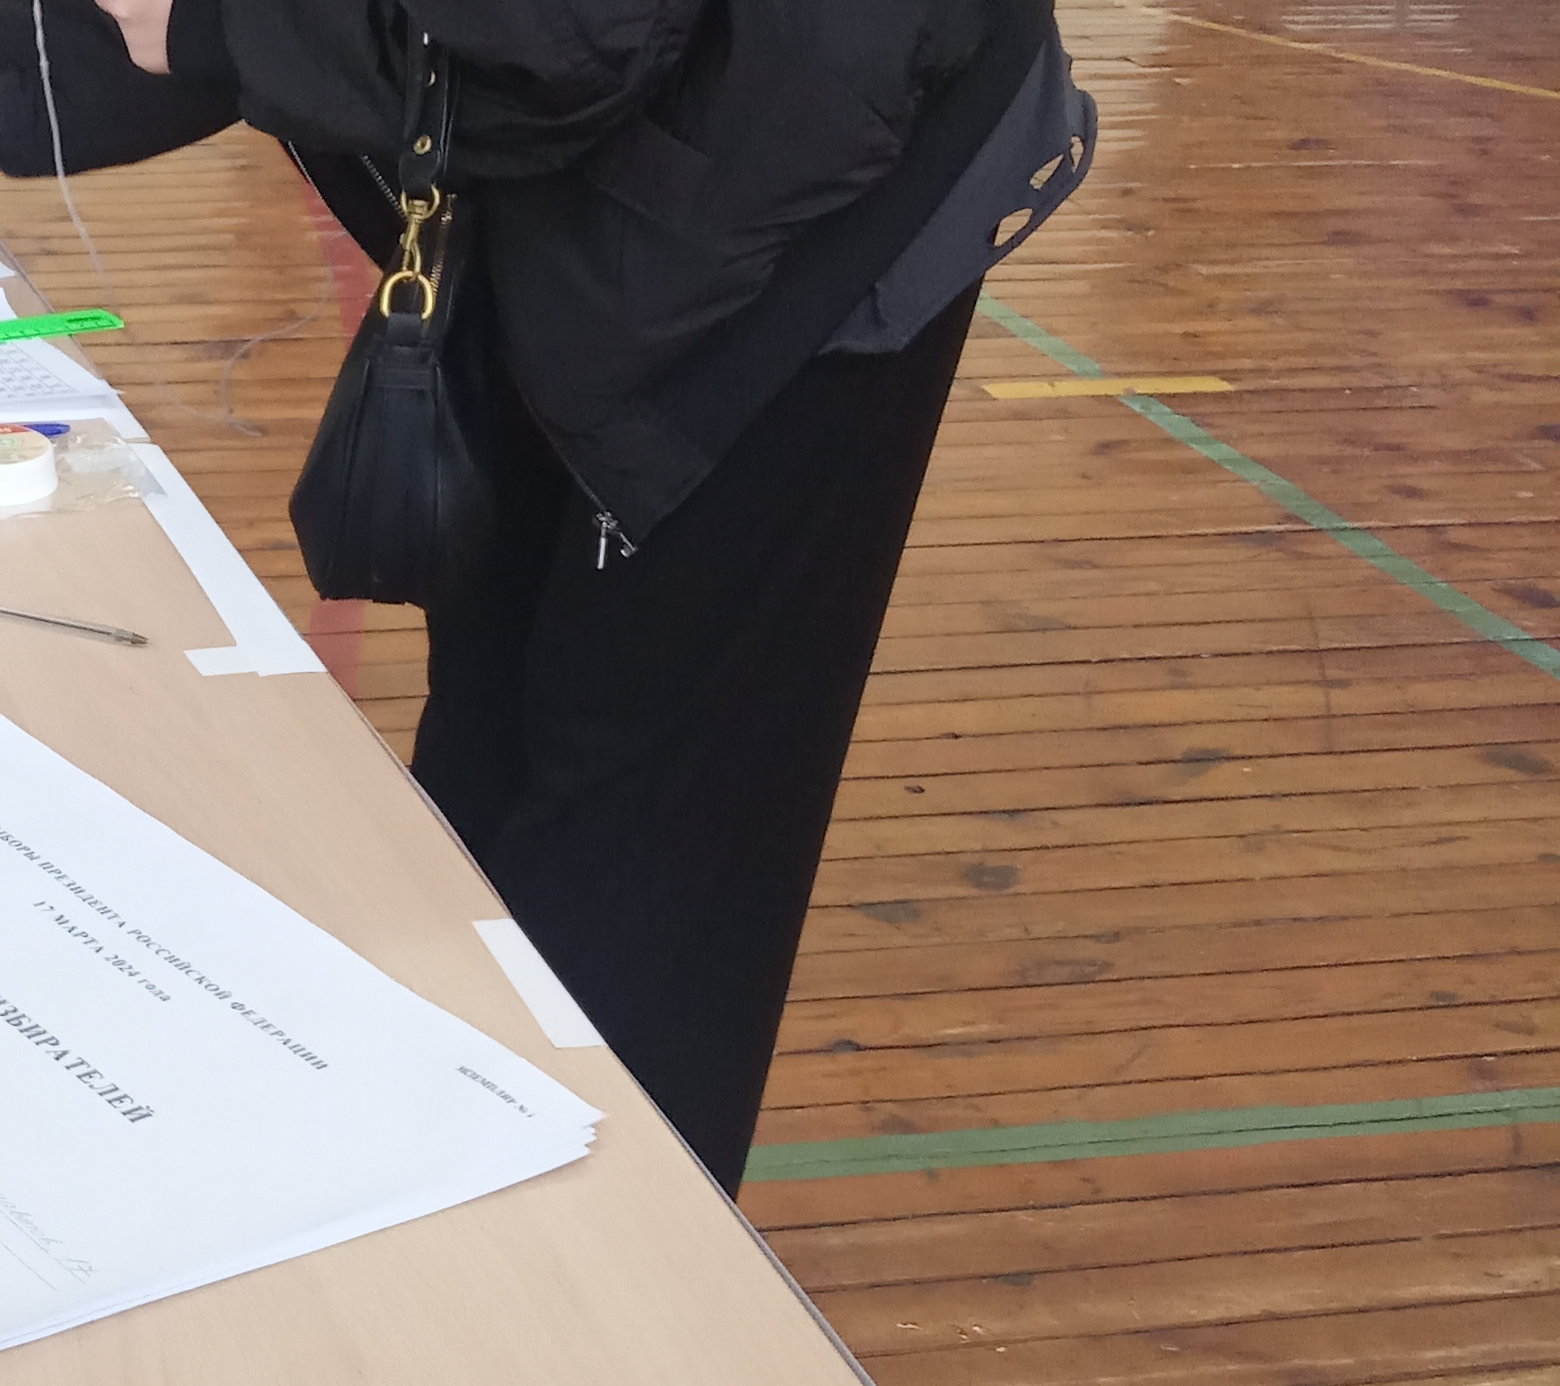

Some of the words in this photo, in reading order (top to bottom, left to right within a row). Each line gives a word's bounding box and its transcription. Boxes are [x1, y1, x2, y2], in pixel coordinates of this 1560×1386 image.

[38, 861, 127, 929] ПРЕЗИДЕНТА
[127, 928, 235, 1002] РОССИЙСКОЙ
[230, 1001, 329, 1070] ФЕДЕРАЦИИ
[52, 914, 104, 954] МАРТА
[103, 953, 141, 979] 2024
[138, 978, 172, 1002] года
